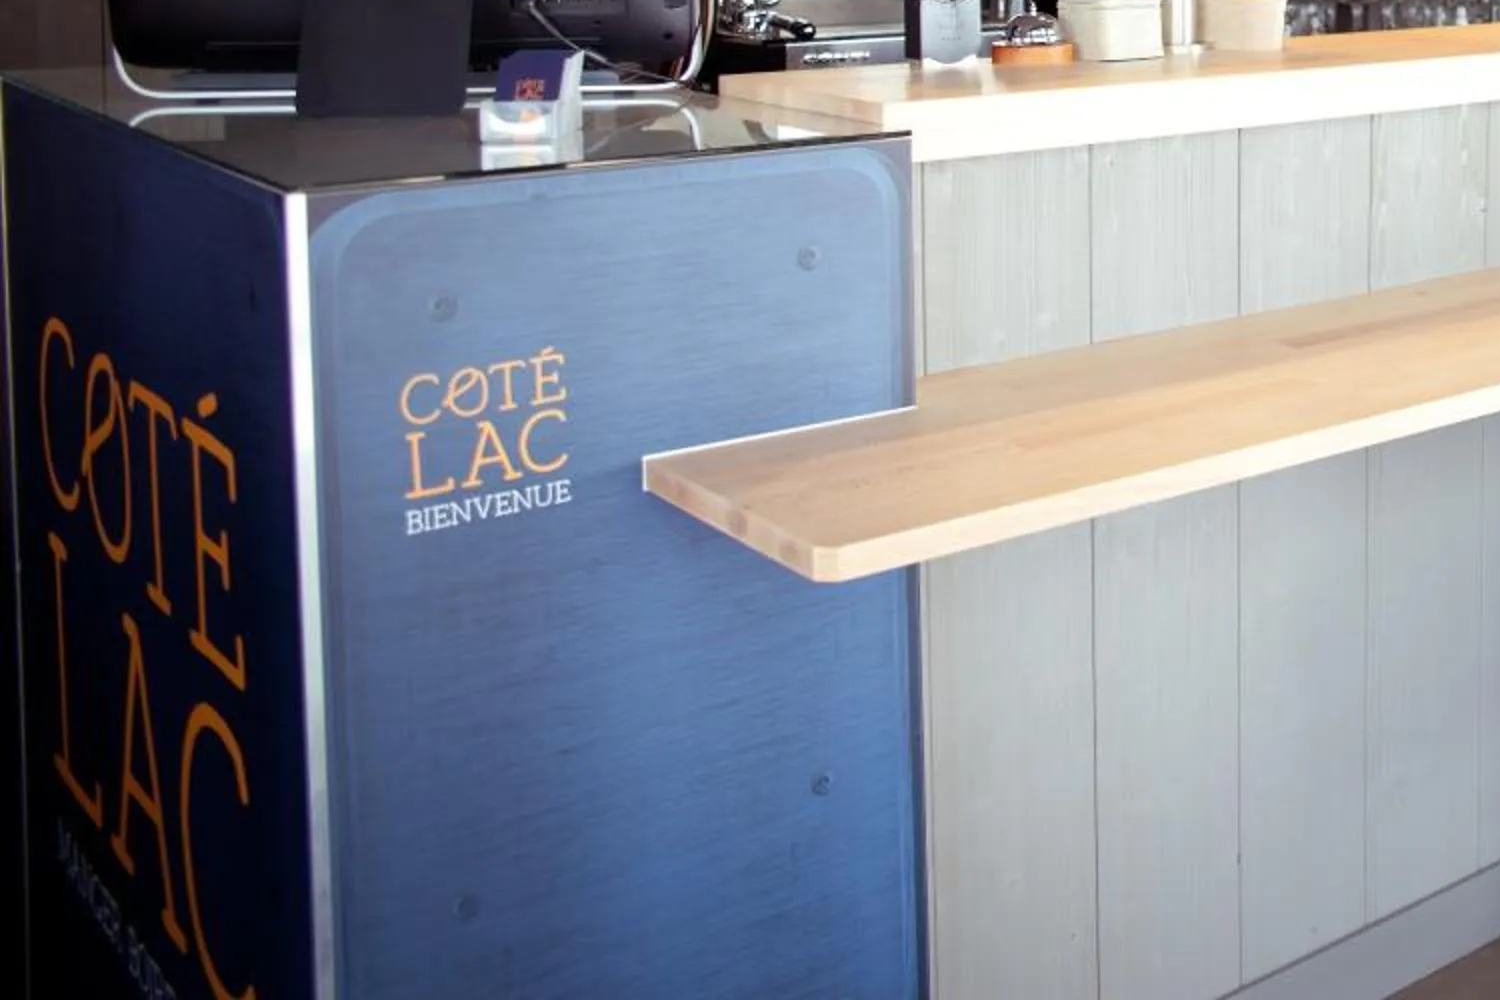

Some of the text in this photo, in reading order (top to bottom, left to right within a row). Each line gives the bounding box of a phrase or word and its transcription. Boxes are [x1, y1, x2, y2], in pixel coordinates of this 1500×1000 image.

[404, 408, 570, 500] LAC
[404, 479, 573, 537] BIENVENUE
[47, 531, 256, 1000] LAC
